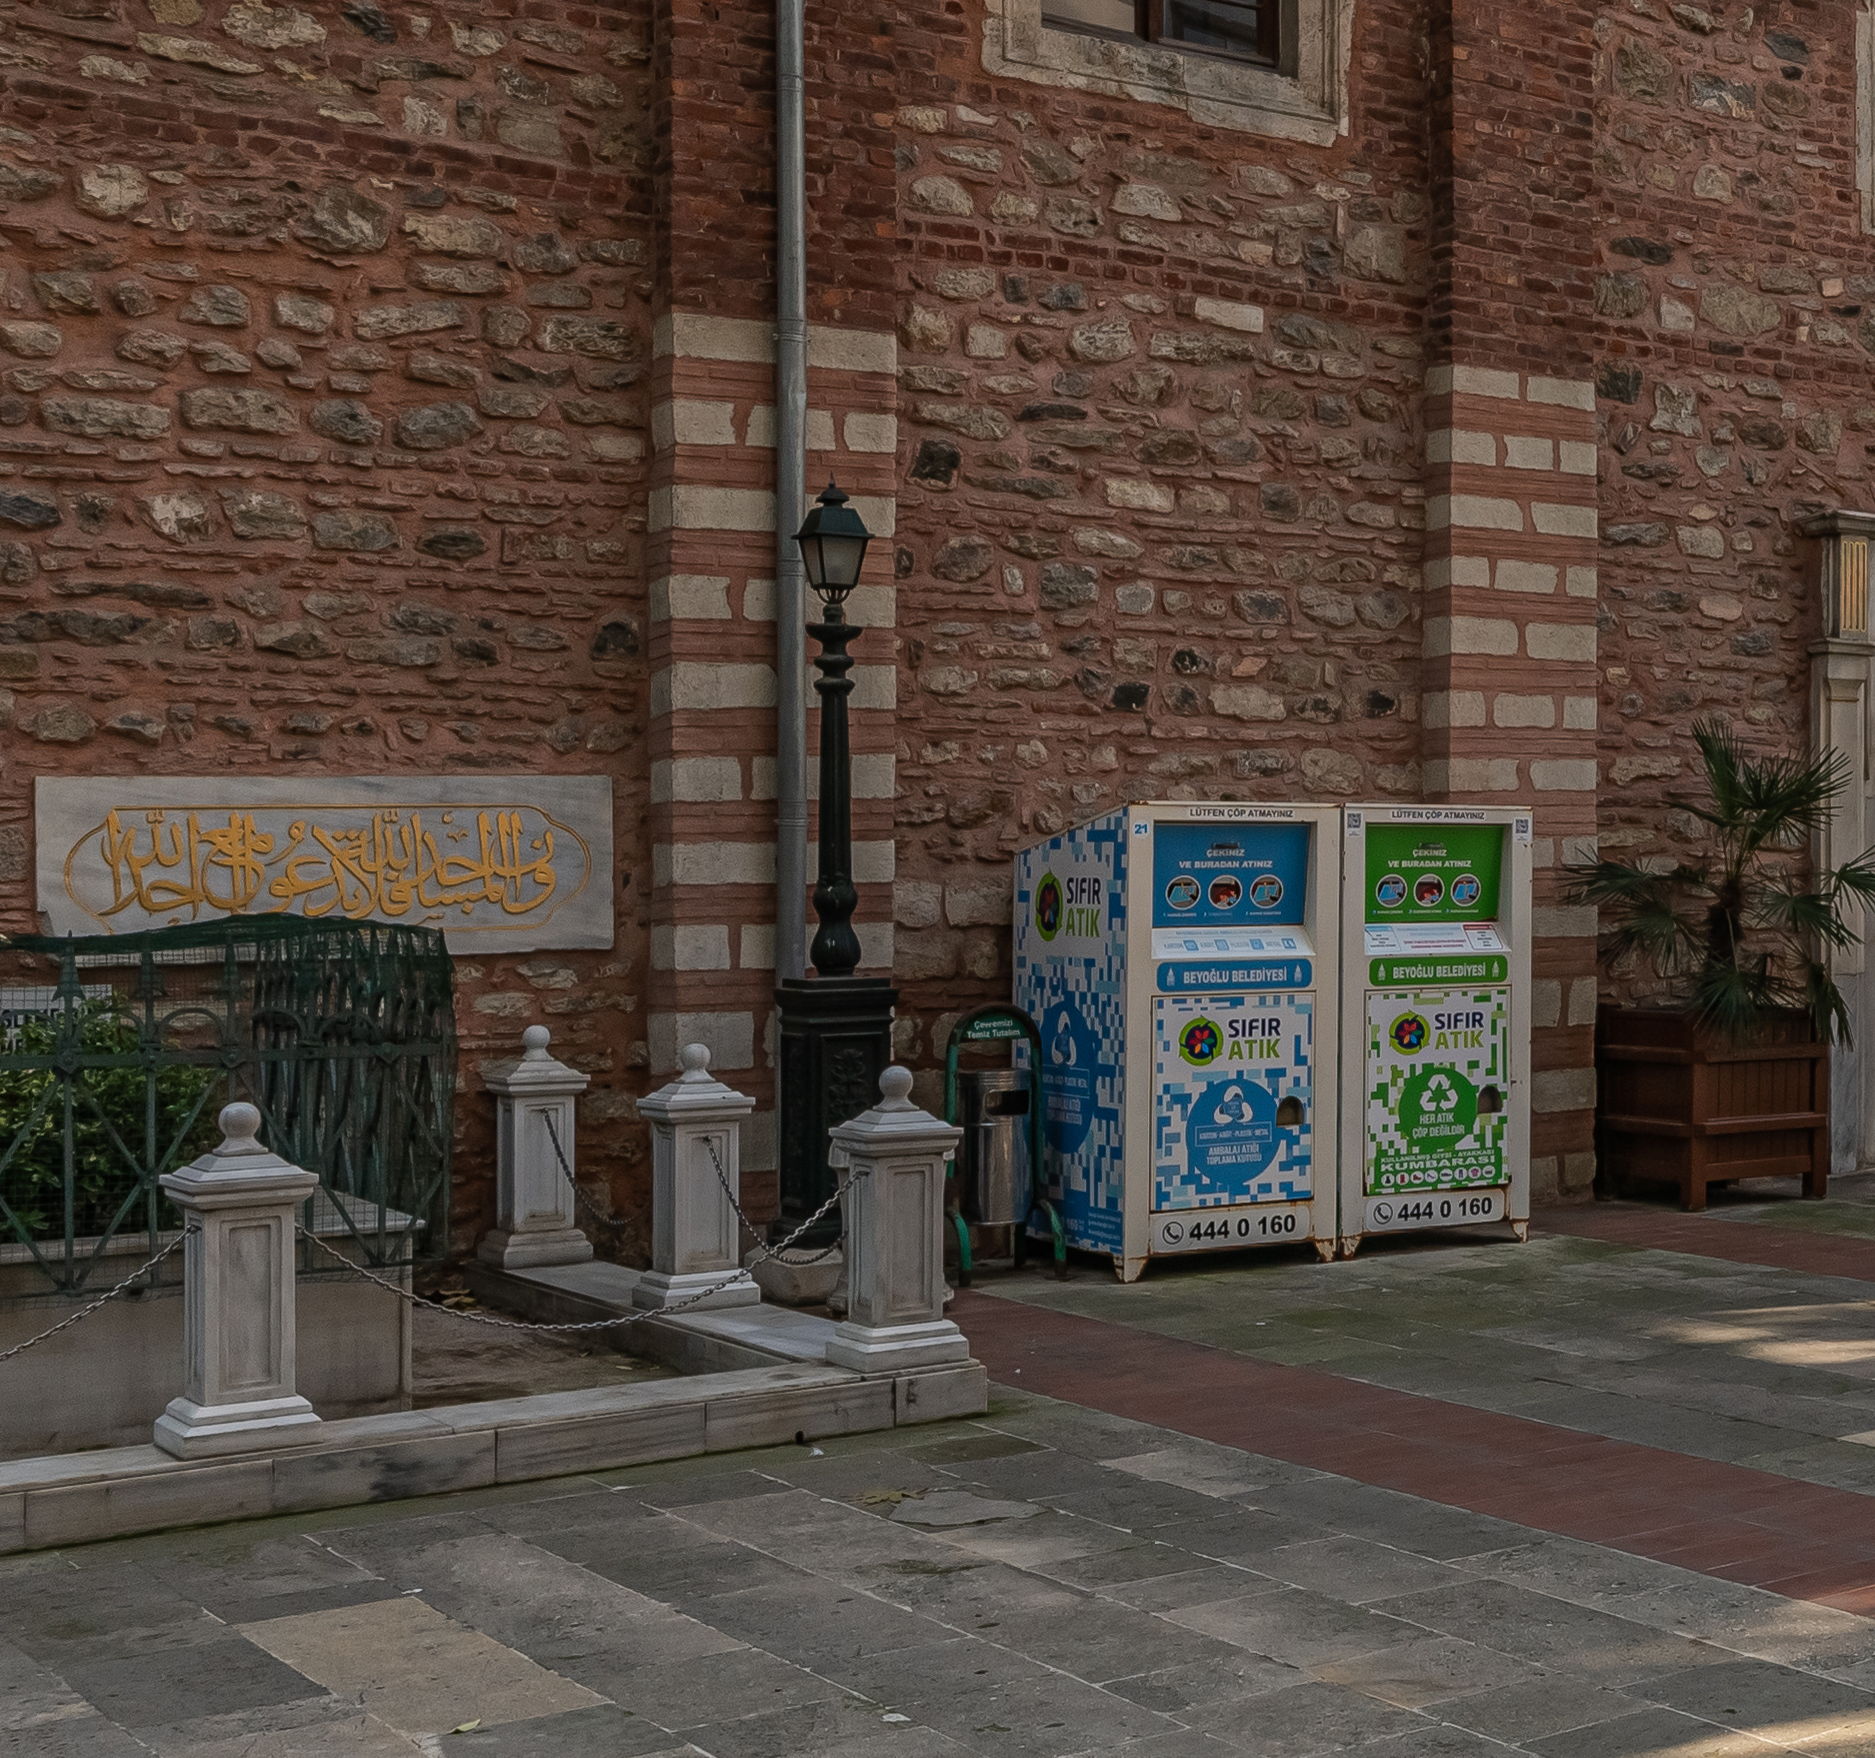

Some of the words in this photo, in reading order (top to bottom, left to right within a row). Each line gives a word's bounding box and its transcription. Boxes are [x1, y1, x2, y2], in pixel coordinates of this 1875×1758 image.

[1190, 808, 1225, 817] LÜTFEN
[1227, 808, 1246, 818] ÇÖP
[1248, 809, 1293, 818] ATMAYINIZ
[1392, 810, 1423, 819] LÜTFEN
[1425, 811, 1442, 820] ÇÖP
[1443, 812, 1484, 820] ATMAYINIZ
[1134, 824, 1148, 834] 21
[1178, 860, 1192, 869] VE
[1194, 860, 1240, 869] BURADAN
[1242, 860, 1273, 868] ATINIZ
[1388, 860, 1400, 868] VE
[1402, 860, 1442, 868] BURADAN
[1444, 860, 1472, 868] ATINIZ
[1066, 877, 1101, 904] SIFIR
[1065, 908, 1100, 938] ATIK
[1183, 968, 1229, 984] BEYOĞLU
[1232, 966, 1287, 982] BELEDİYESİ
[1392, 964, 1434, 978] BEYOĞLU
[1436, 962, 1486, 978] BELEDİYESİ
[1228, 1018, 1281, 1038] SIFIR
[1434, 1012, 1484, 1030] SIFIR
[1434, 1030, 1484, 1050] ATIK
[1228, 1038, 1280, 1060] ATIK
[1420, 1114, 1436, 1124] HER
[1436, 1112, 1454, 1122] ATIK
[1412, 1128, 1428, 1138] ÇÖP
[1430, 1124, 1465, 1136] DEĞİLDİR
[1380, 1155, 1495, 1172] KUMBARASI
[1398, 1202, 1434, 1222] 444
[1440, 1200, 1452, 1218] 0
[1458, 1197, 1493, 1217] 160
[1189, 1220, 1230, 1240] 444
[1236, 1218, 1250, 1237] 0
[1258, 1214, 1296, 1235] 160
